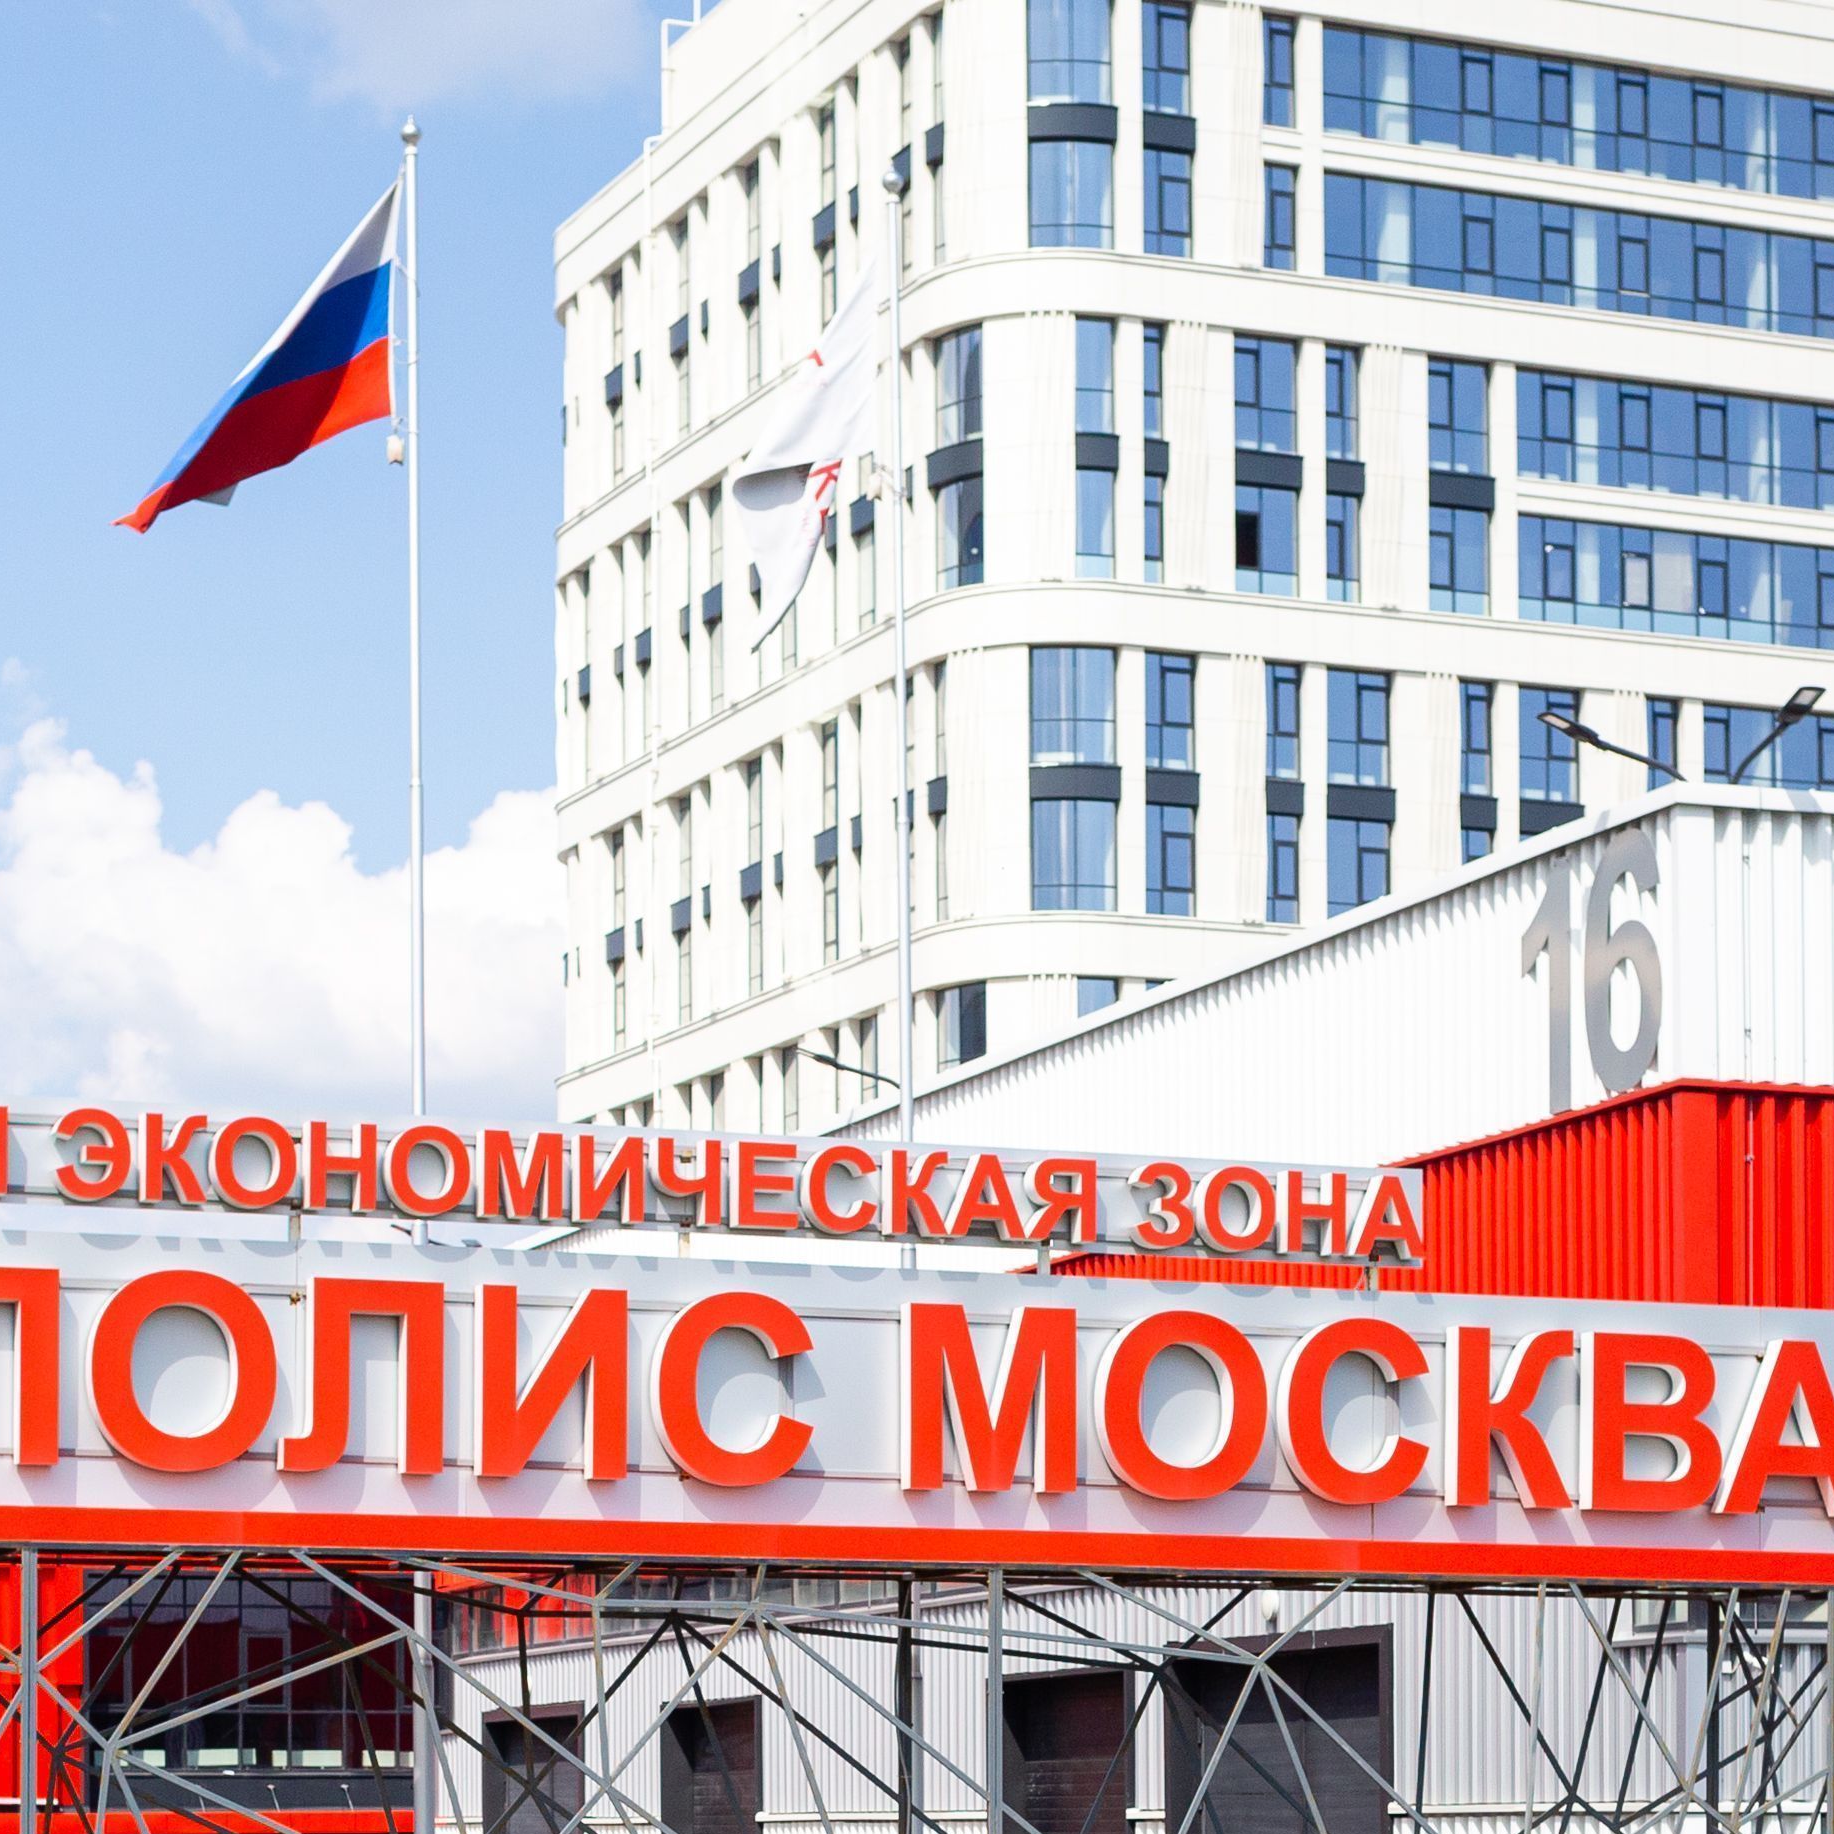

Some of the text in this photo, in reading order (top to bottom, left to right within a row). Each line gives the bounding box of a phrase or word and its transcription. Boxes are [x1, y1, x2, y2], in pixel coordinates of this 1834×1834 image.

[1521, 827, 1662, 1115] 16
[52, 1107, 1097, 1247] ЭКОНОМИЧЕСКАЯ
[1129, 1161, 1424, 1259] ЗОНА
